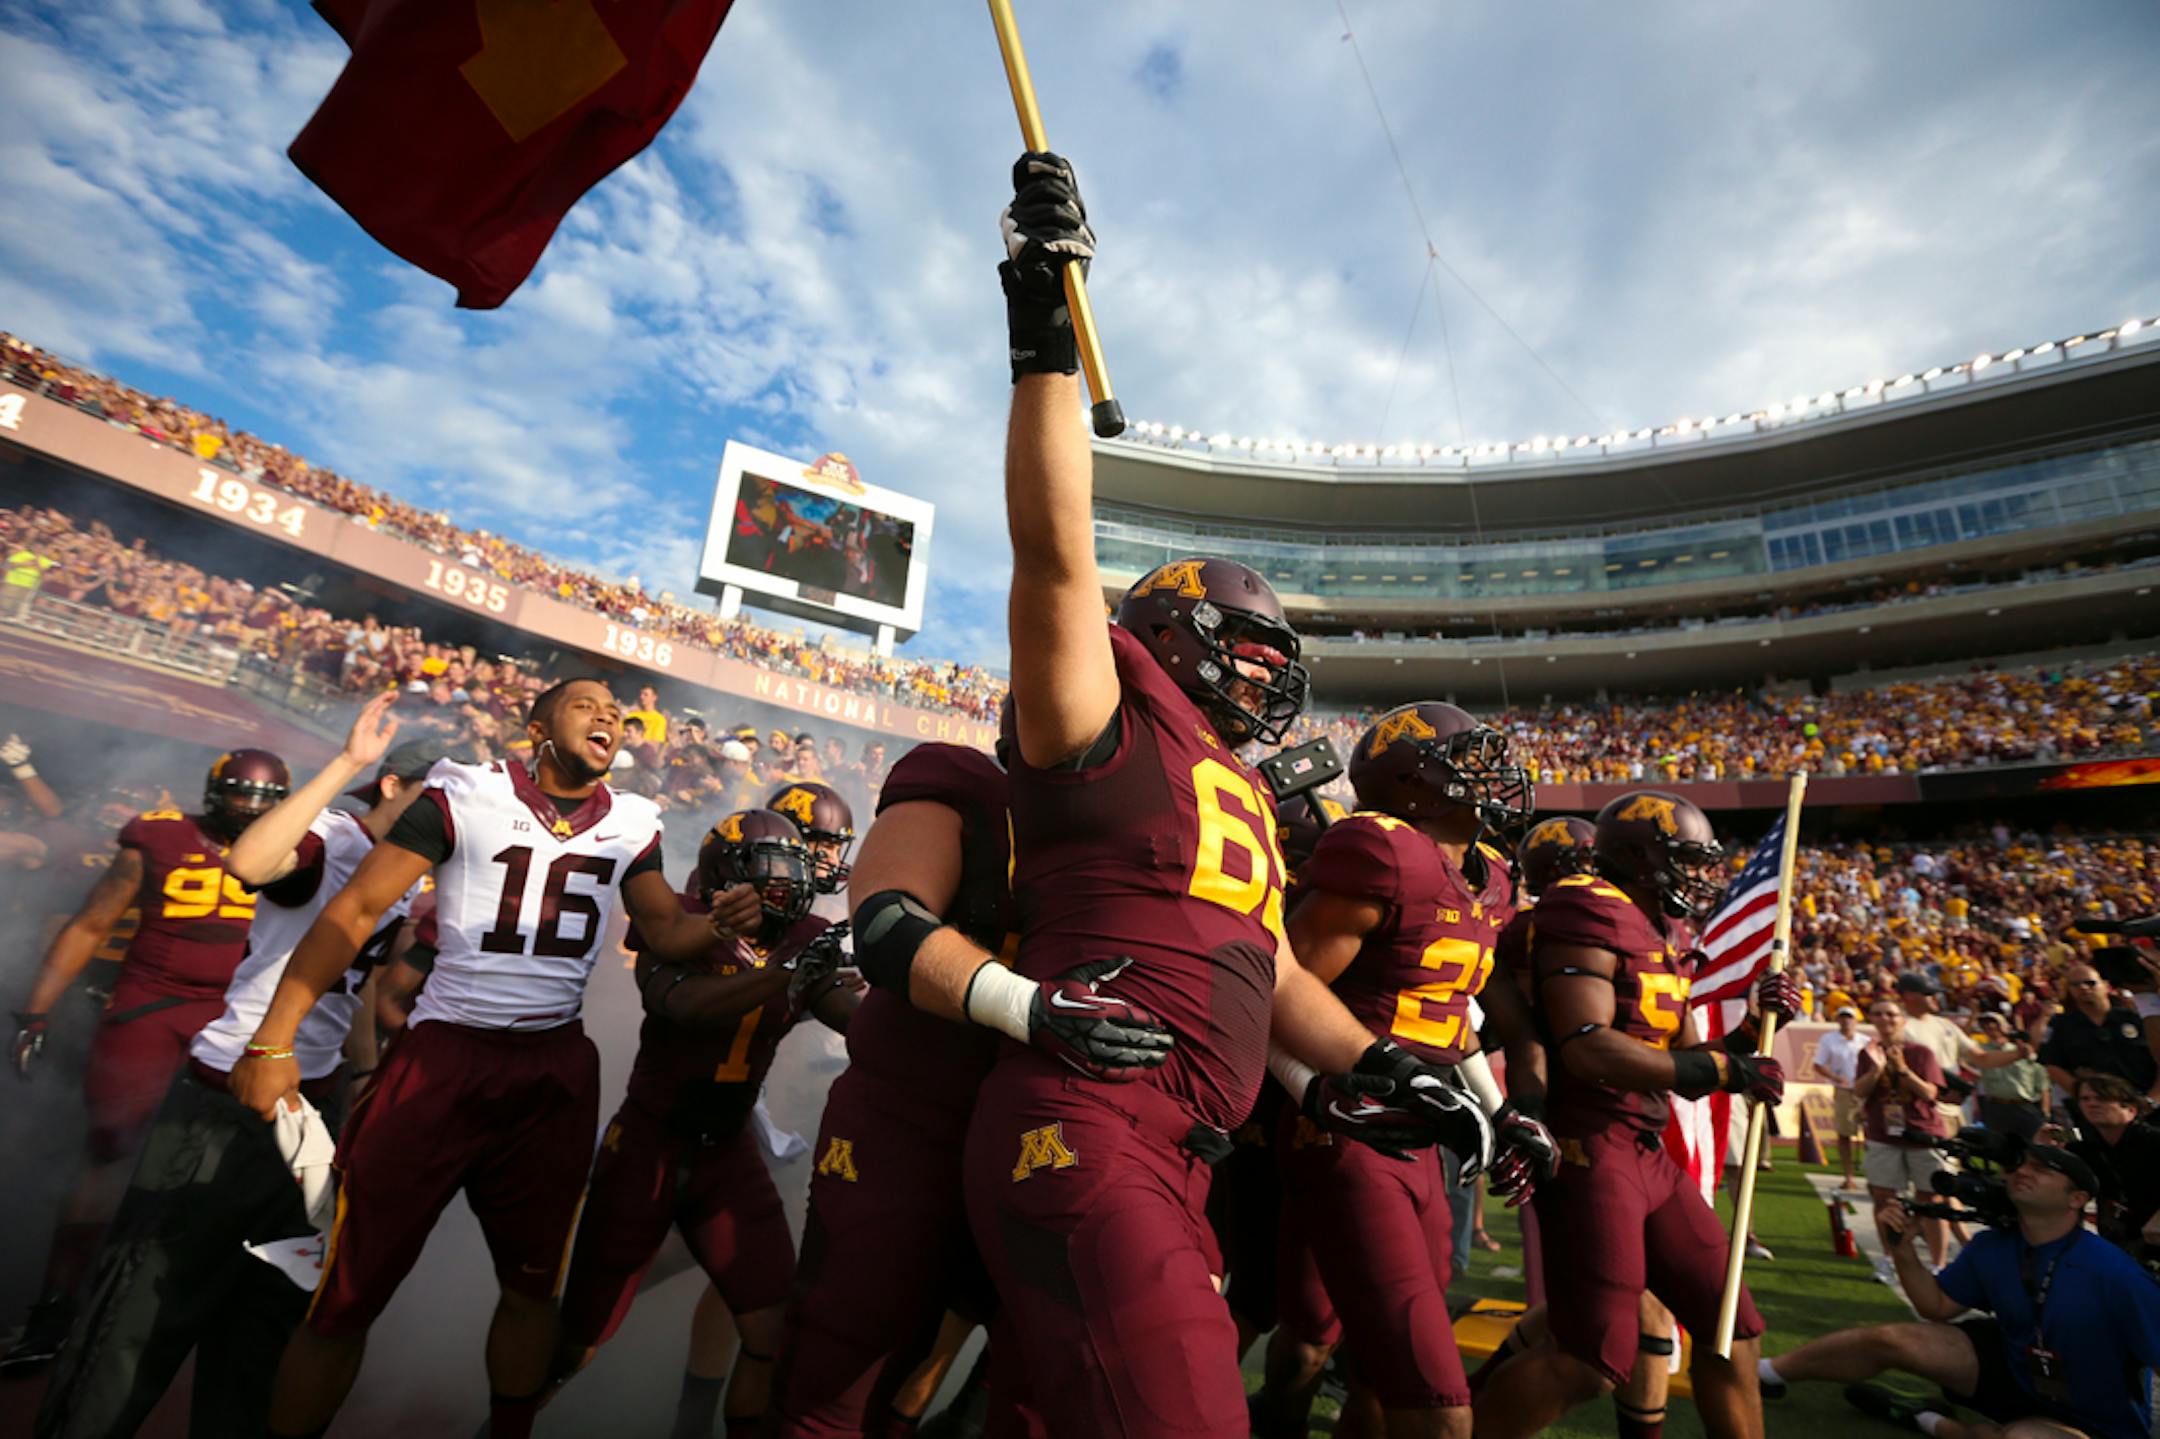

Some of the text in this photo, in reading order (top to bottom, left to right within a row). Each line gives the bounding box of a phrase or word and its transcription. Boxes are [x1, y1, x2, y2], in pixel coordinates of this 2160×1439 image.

[191, 467, 306, 538] 1934
[424, 560, 509, 613] 1935
[602, 624, 673, 667] 1936
[755, 673, 1000, 748] NATIONAL CHAM
[480, 844, 617, 958] 16
